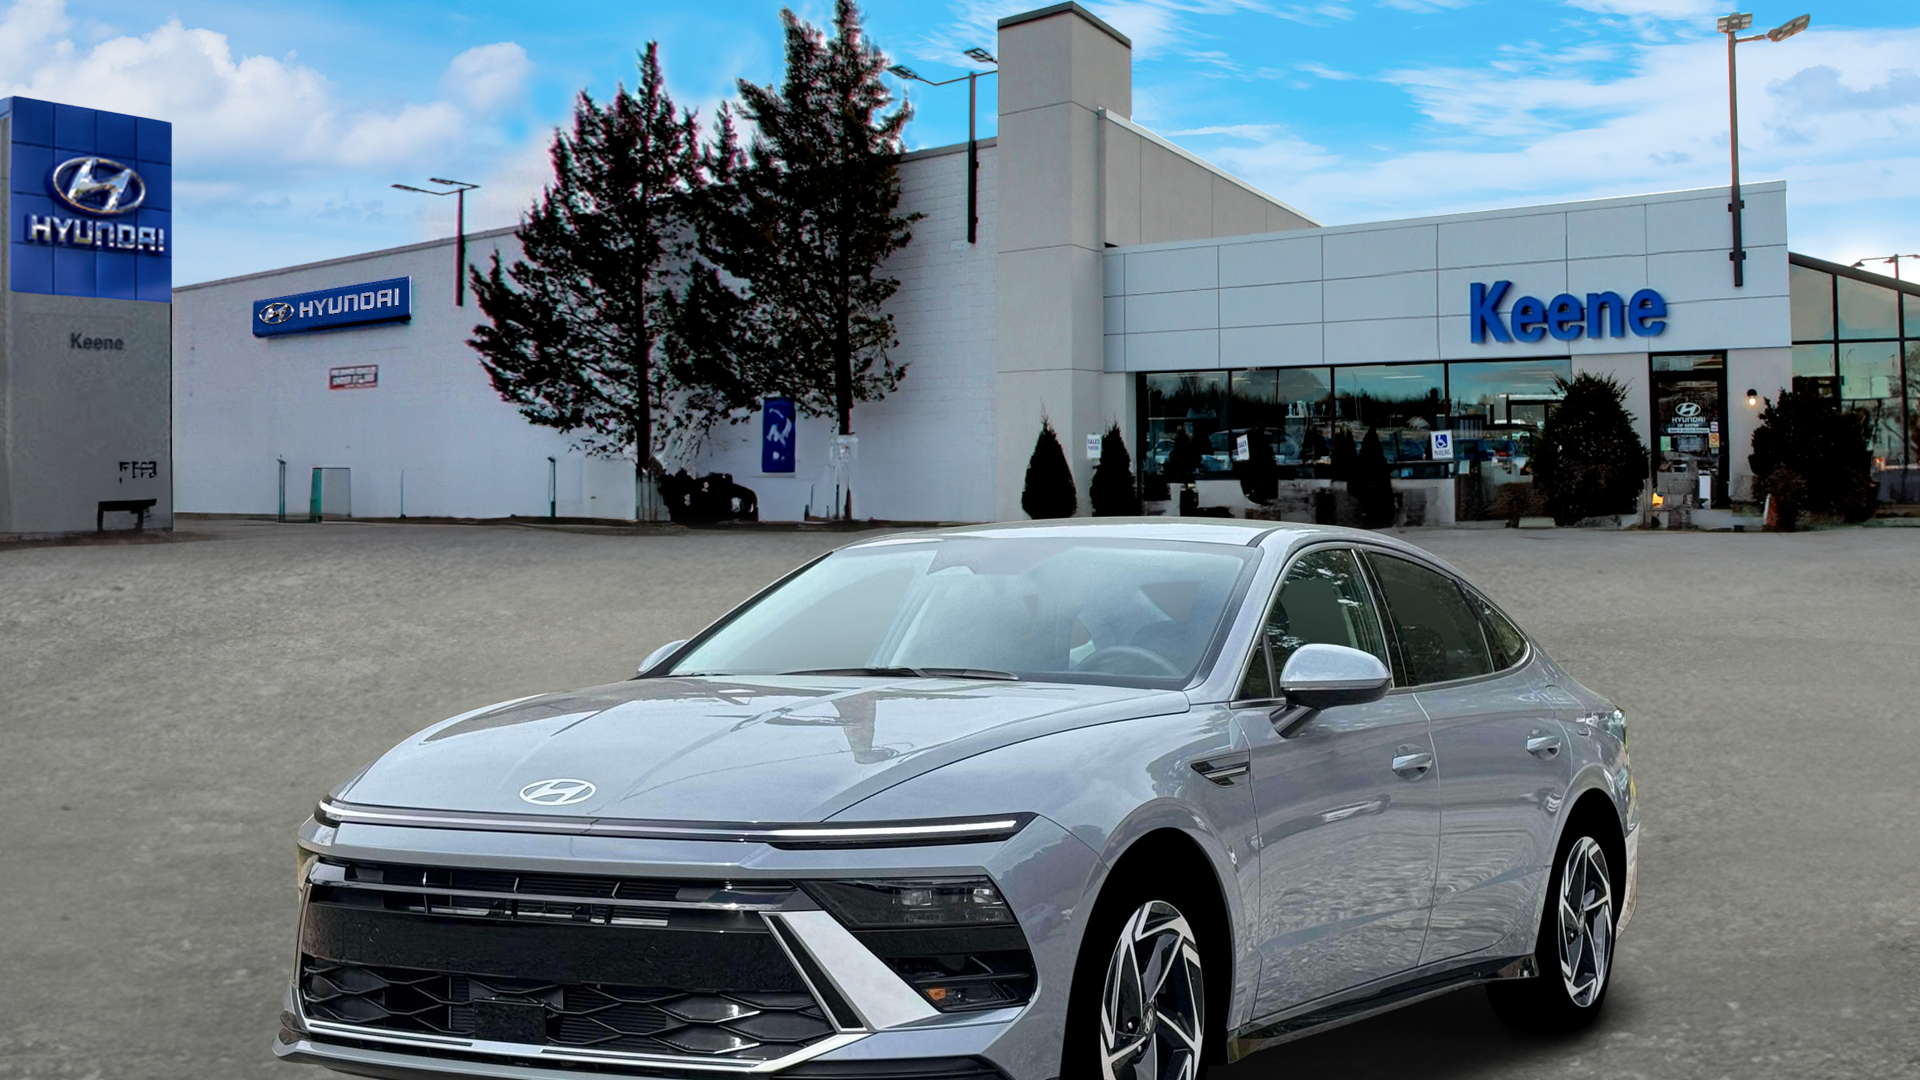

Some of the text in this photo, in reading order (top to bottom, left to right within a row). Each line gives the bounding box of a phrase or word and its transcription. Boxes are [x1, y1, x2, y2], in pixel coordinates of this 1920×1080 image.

[29, 214, 165, 252] HYUNDAI
[300, 287, 399, 318] HYUNDAI
[1470, 280, 1668, 344] Keene
[70, 332, 125, 351] Keene
